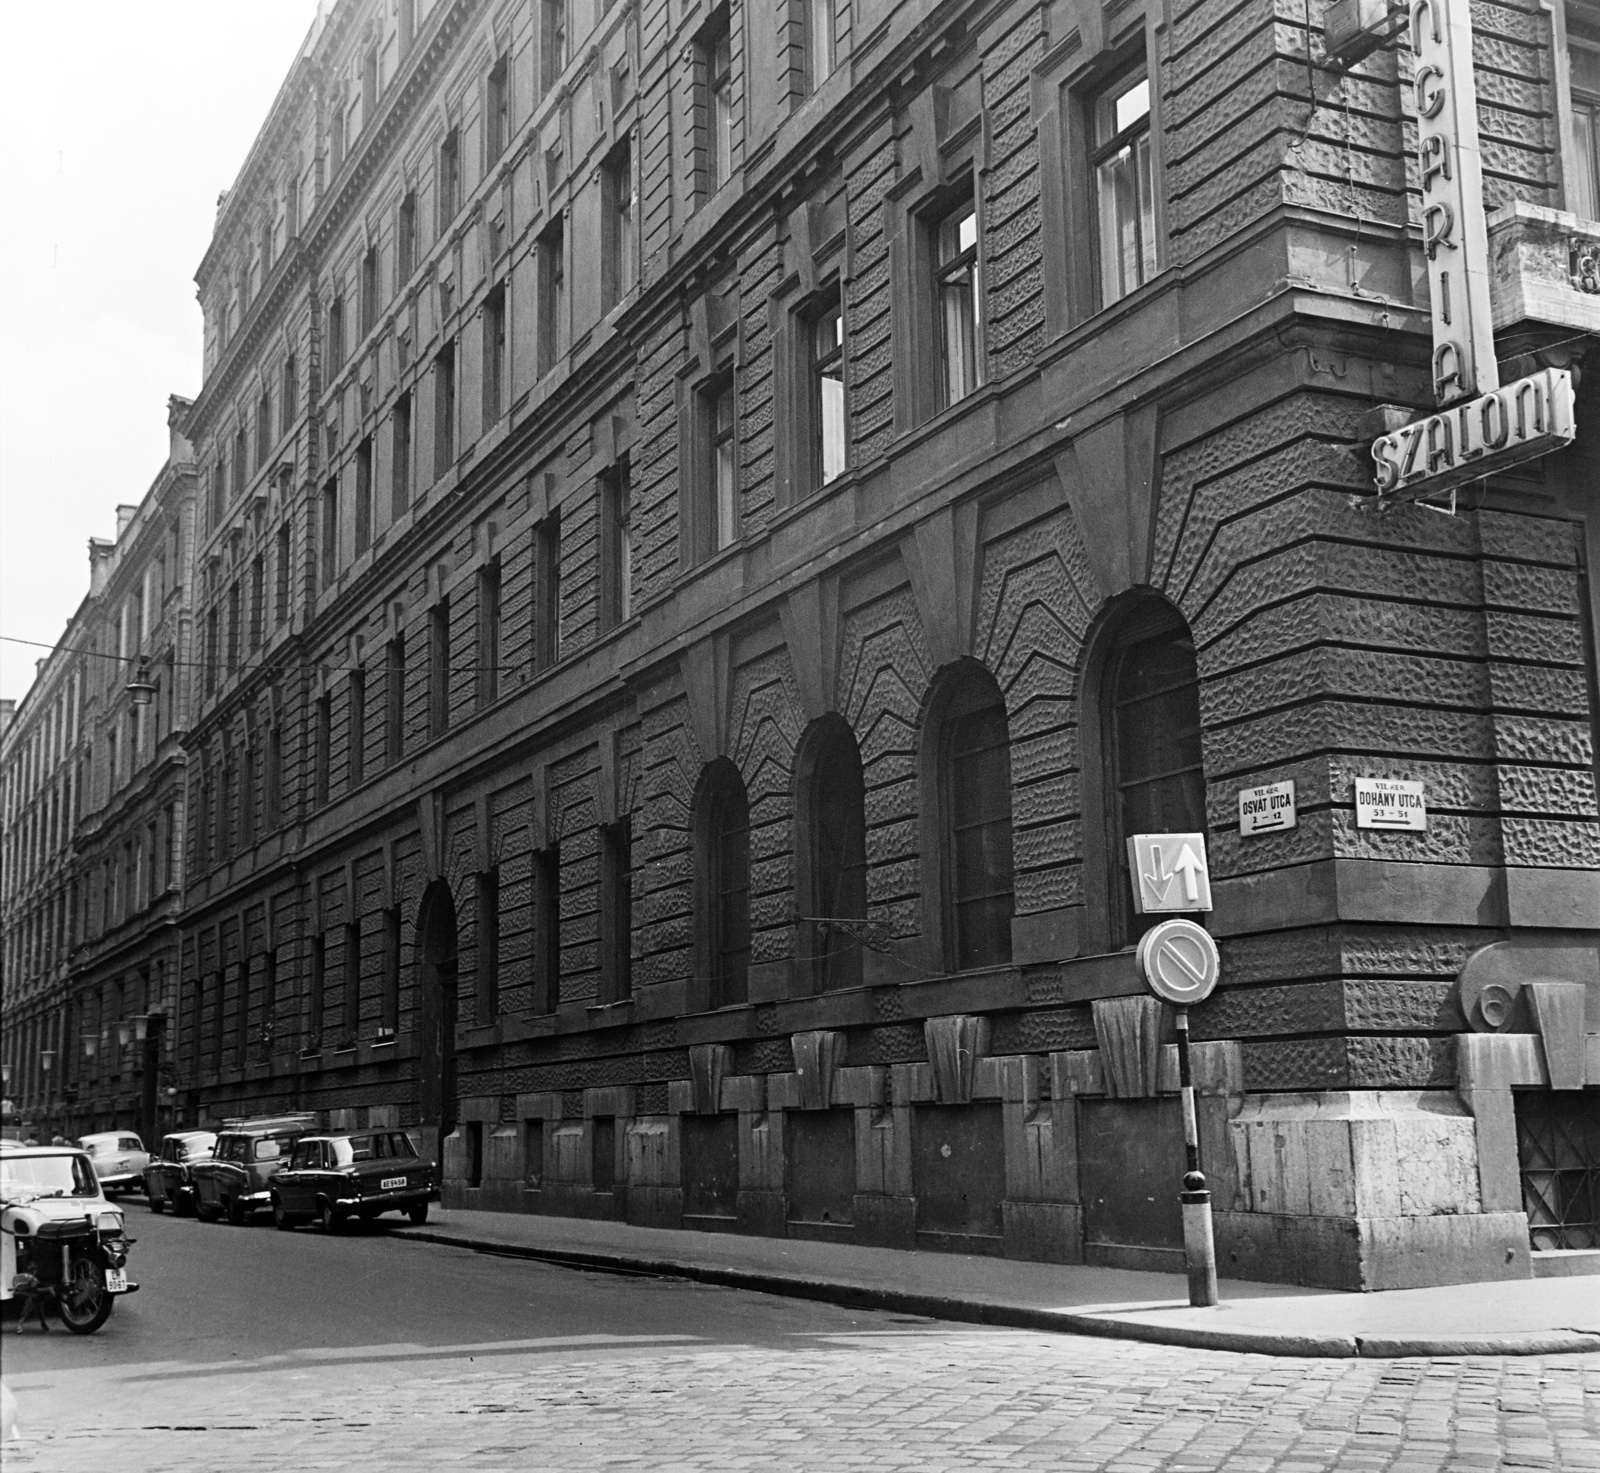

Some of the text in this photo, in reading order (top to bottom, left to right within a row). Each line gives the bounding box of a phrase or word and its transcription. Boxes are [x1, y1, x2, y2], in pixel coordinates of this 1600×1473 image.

[1371, 378, 1545, 490] SZALON
[1243, 793, 1291, 816] OSVÁT UTCA
[1359, 790, 1423, 809] DOHÁNY UTCA
[1252, 816, 1258, 824] 2
[1273, 811, 1282, 820] 12
[1373, 808, 1385, 817] 53
[1397, 810, 1408, 818] 51
